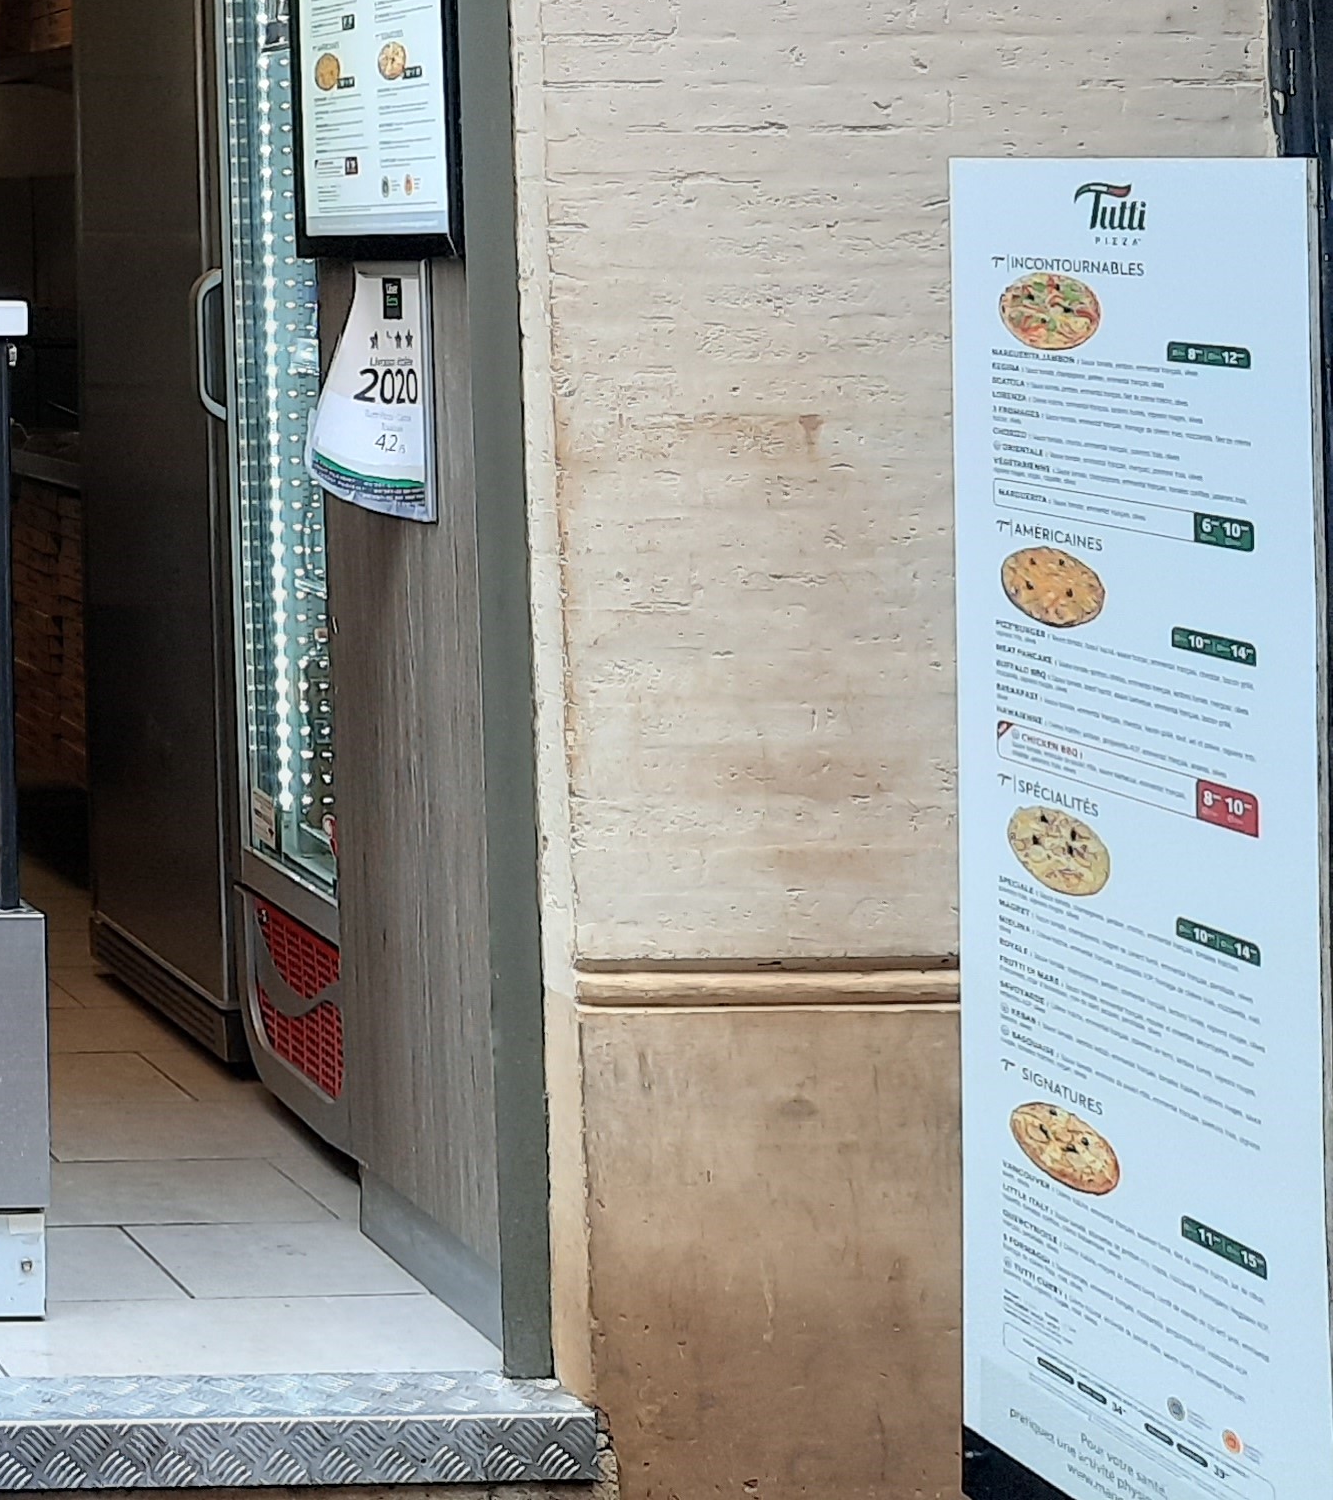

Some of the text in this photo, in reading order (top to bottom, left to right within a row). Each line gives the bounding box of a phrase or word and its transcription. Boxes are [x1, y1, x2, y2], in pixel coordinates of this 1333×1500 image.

[1074, 182, 1146, 230] Tutti
[1012, 256, 1144, 276] INCONTOURNABLES
[353, 368, 418, 405] 2020
[1015, 524, 1102, 550] AMÉRICAINES
[1018, 780, 1099, 817] SPÉCIALITÉS
[1022, 1067, 1103, 1115] SIGNATURES
